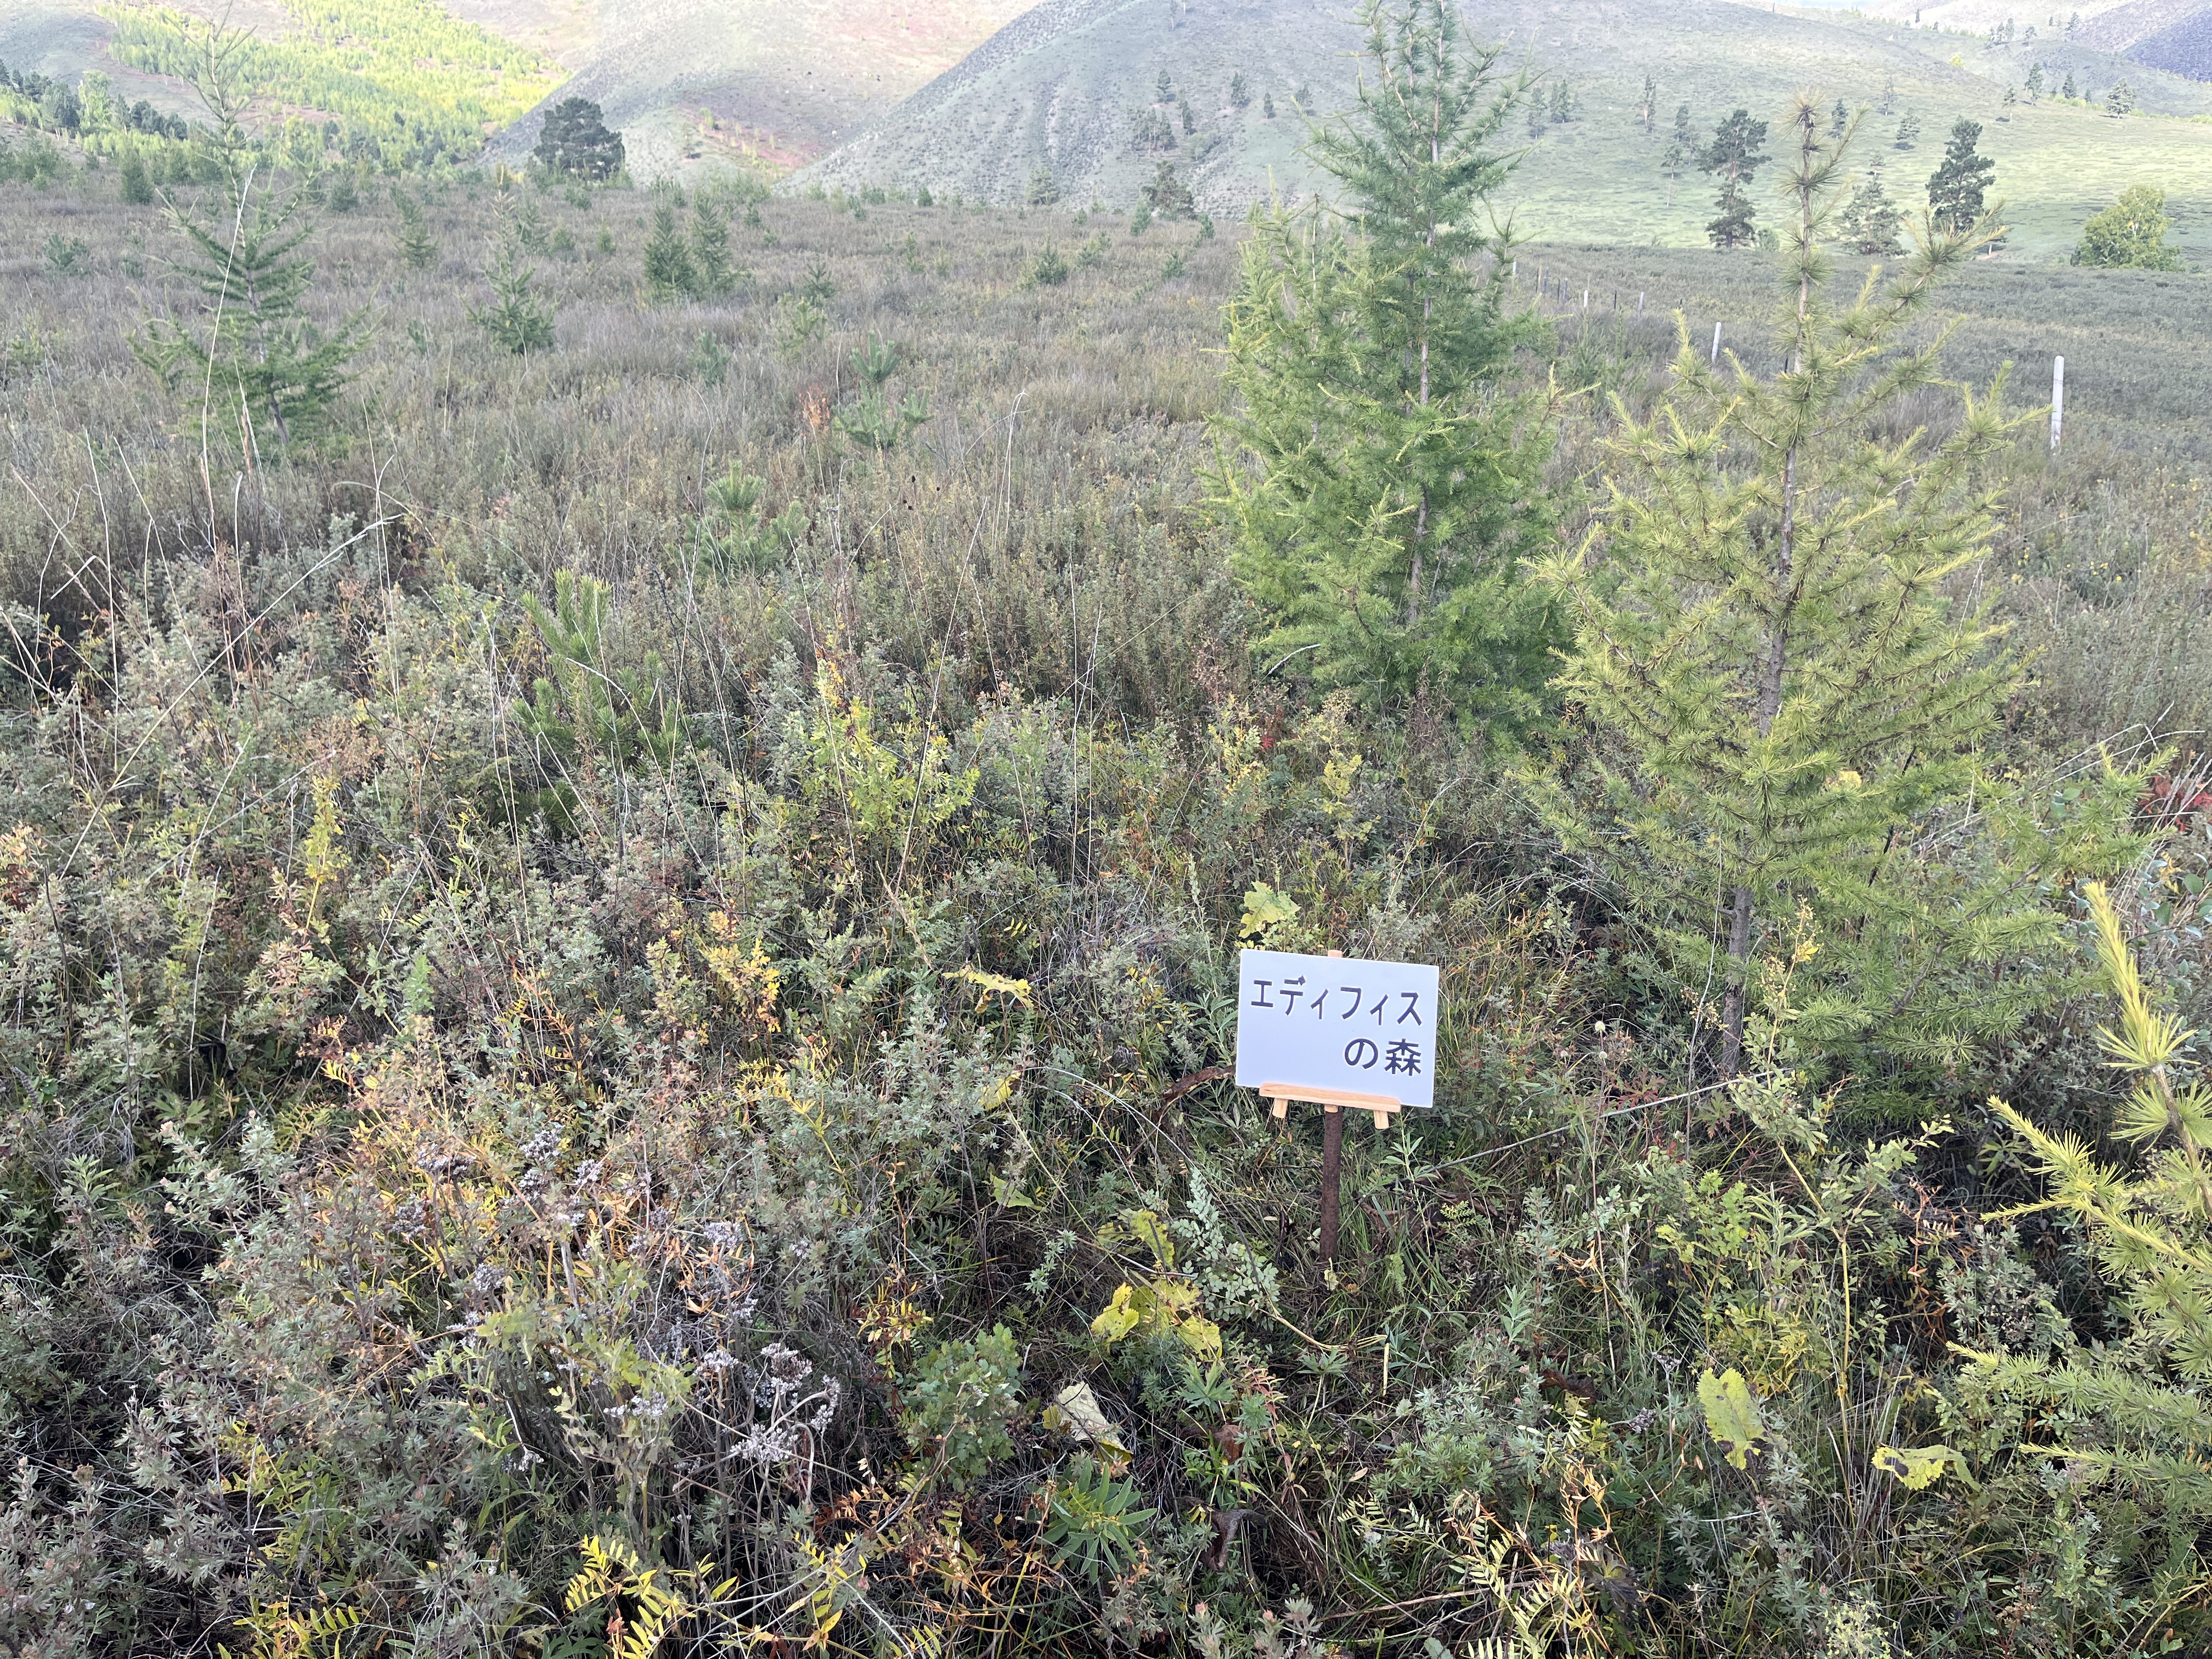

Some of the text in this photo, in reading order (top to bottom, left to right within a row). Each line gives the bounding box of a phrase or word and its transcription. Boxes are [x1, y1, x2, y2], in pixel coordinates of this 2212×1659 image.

[1251, 975, 1422, 1026] エディフィス
[1344, 1039, 1421, 1076] の森
